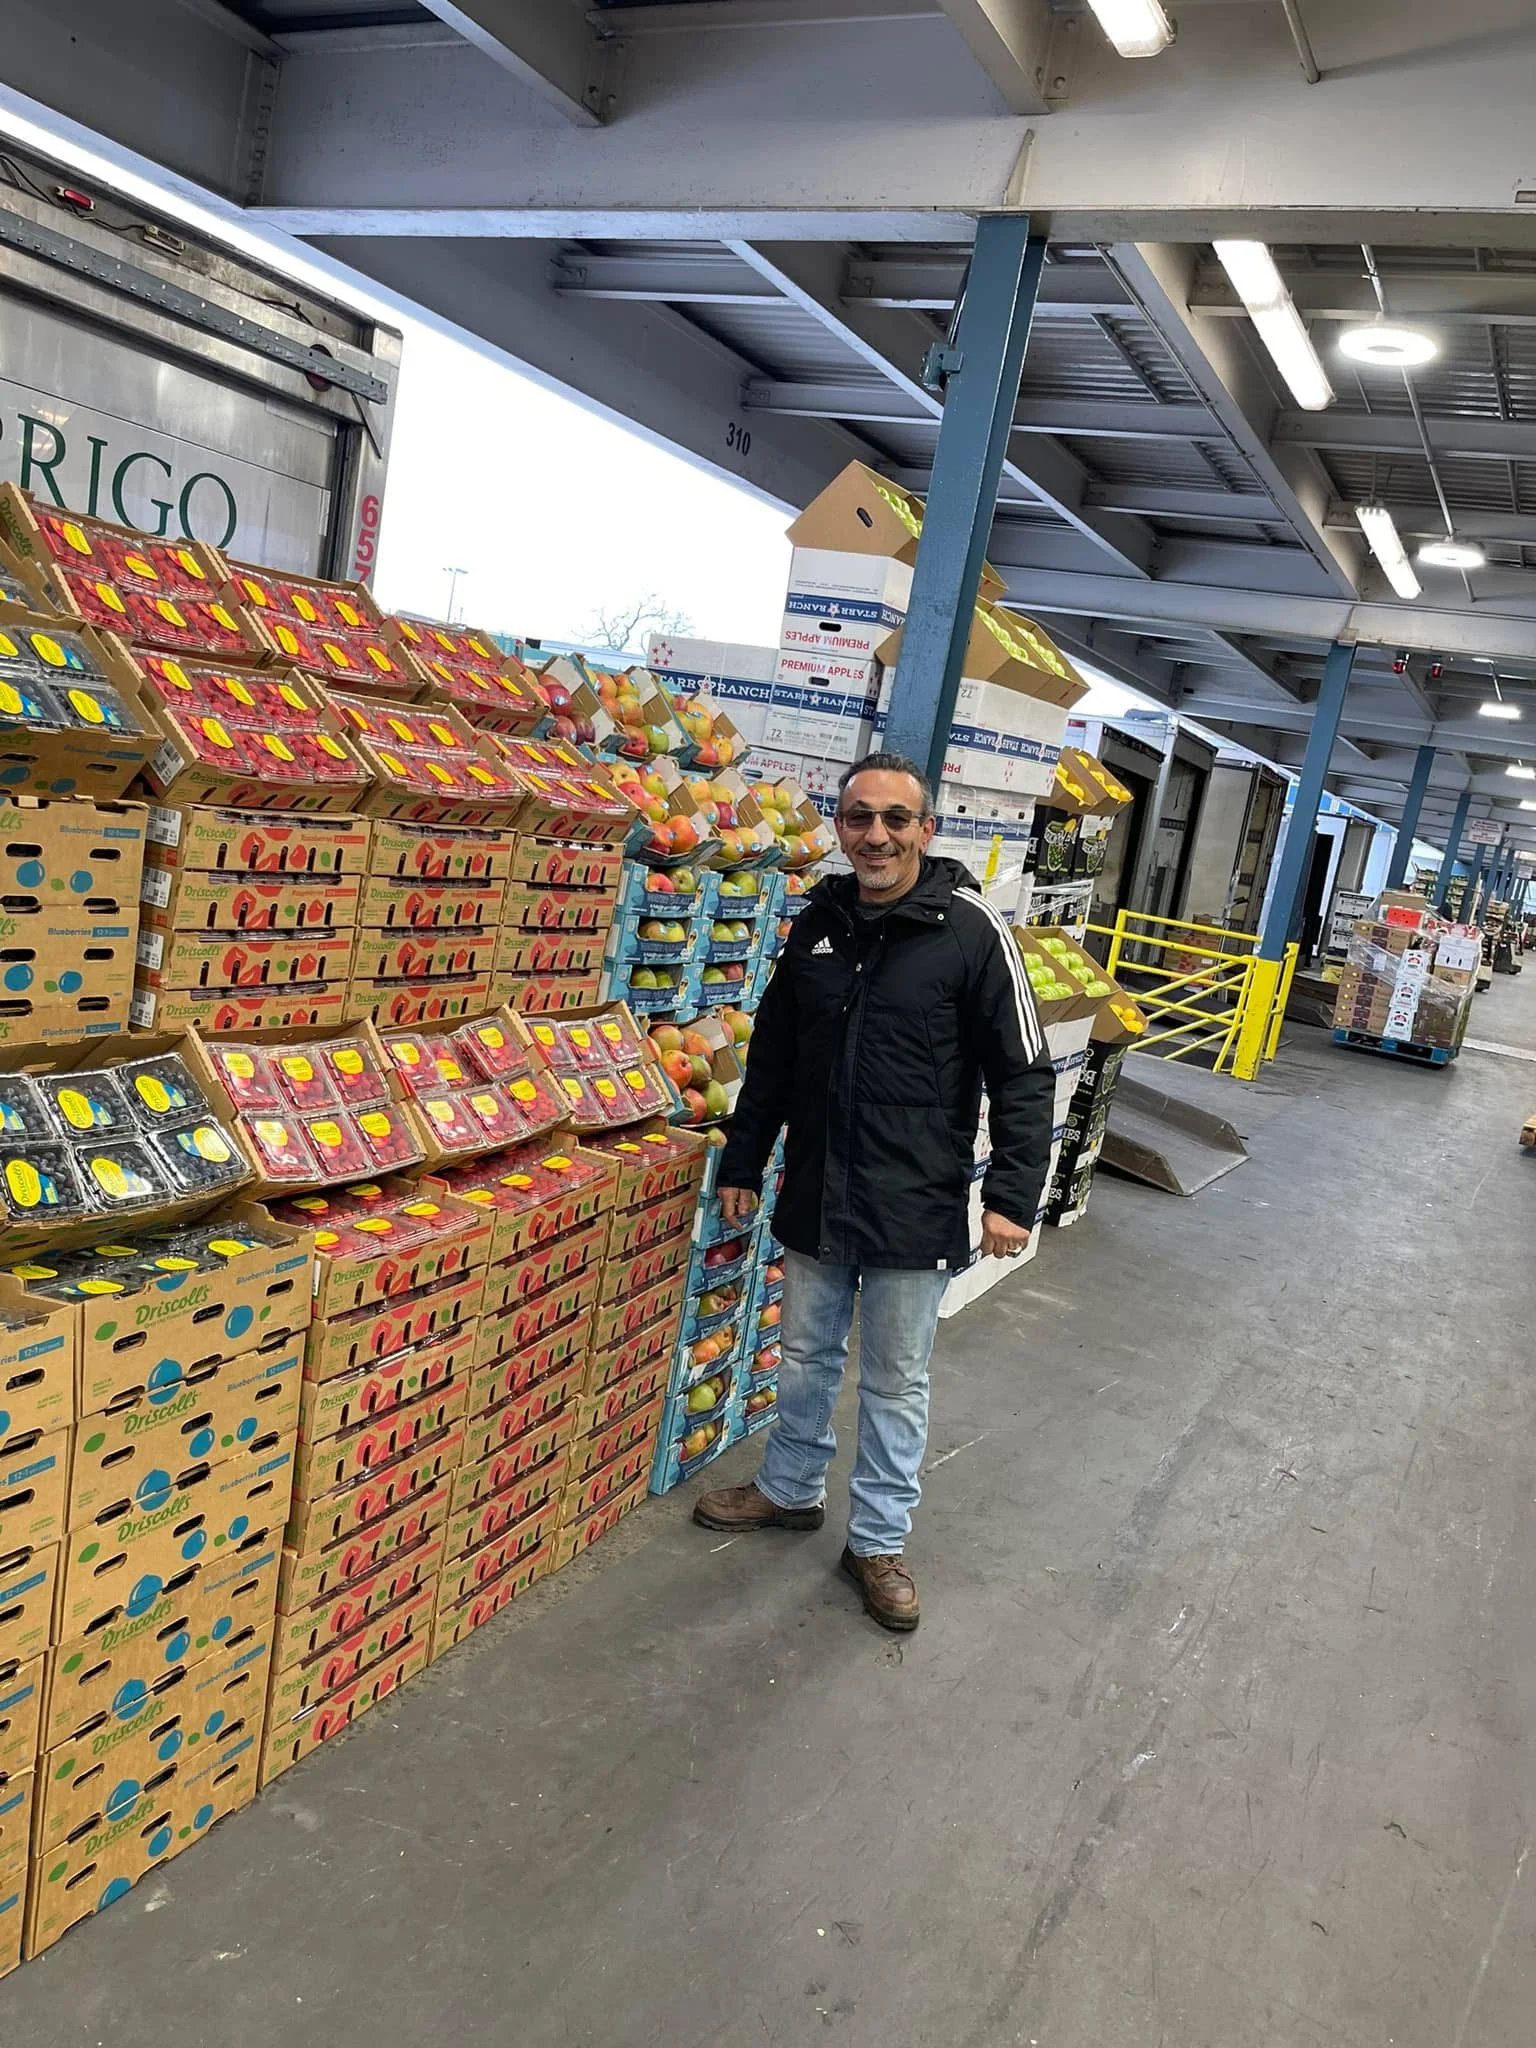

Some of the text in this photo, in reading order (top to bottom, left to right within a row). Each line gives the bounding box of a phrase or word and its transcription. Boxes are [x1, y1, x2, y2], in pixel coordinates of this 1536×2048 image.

[726, 422, 751, 456] 310
[0, 413, 237, 549] RIGO
[788, 600, 878, 620] STARR RANCH
[785, 630, 870, 651] PREMIUM APPLES
[781, 658, 864, 681] PREMIUM APPLES
[716, 682, 771, 699] RANCH
[774, 689, 862, 710] STARR RANCH
[771, 728, 782, 738] 72
[760, 758, 797, 773] APPLES
[811, 947, 833, 955] adidas
[134, 1285, 211, 1325] Driscoll's
[124, 1389, 199, 1434] Driscoll's
[116, 1493, 192, 1542] Driscoll's
[100, 1598, 174, 1650] Driscoll's
[91, 1700, 164, 1755] Driscoll's
[84, 1799, 156, 1856] Driscoll's
